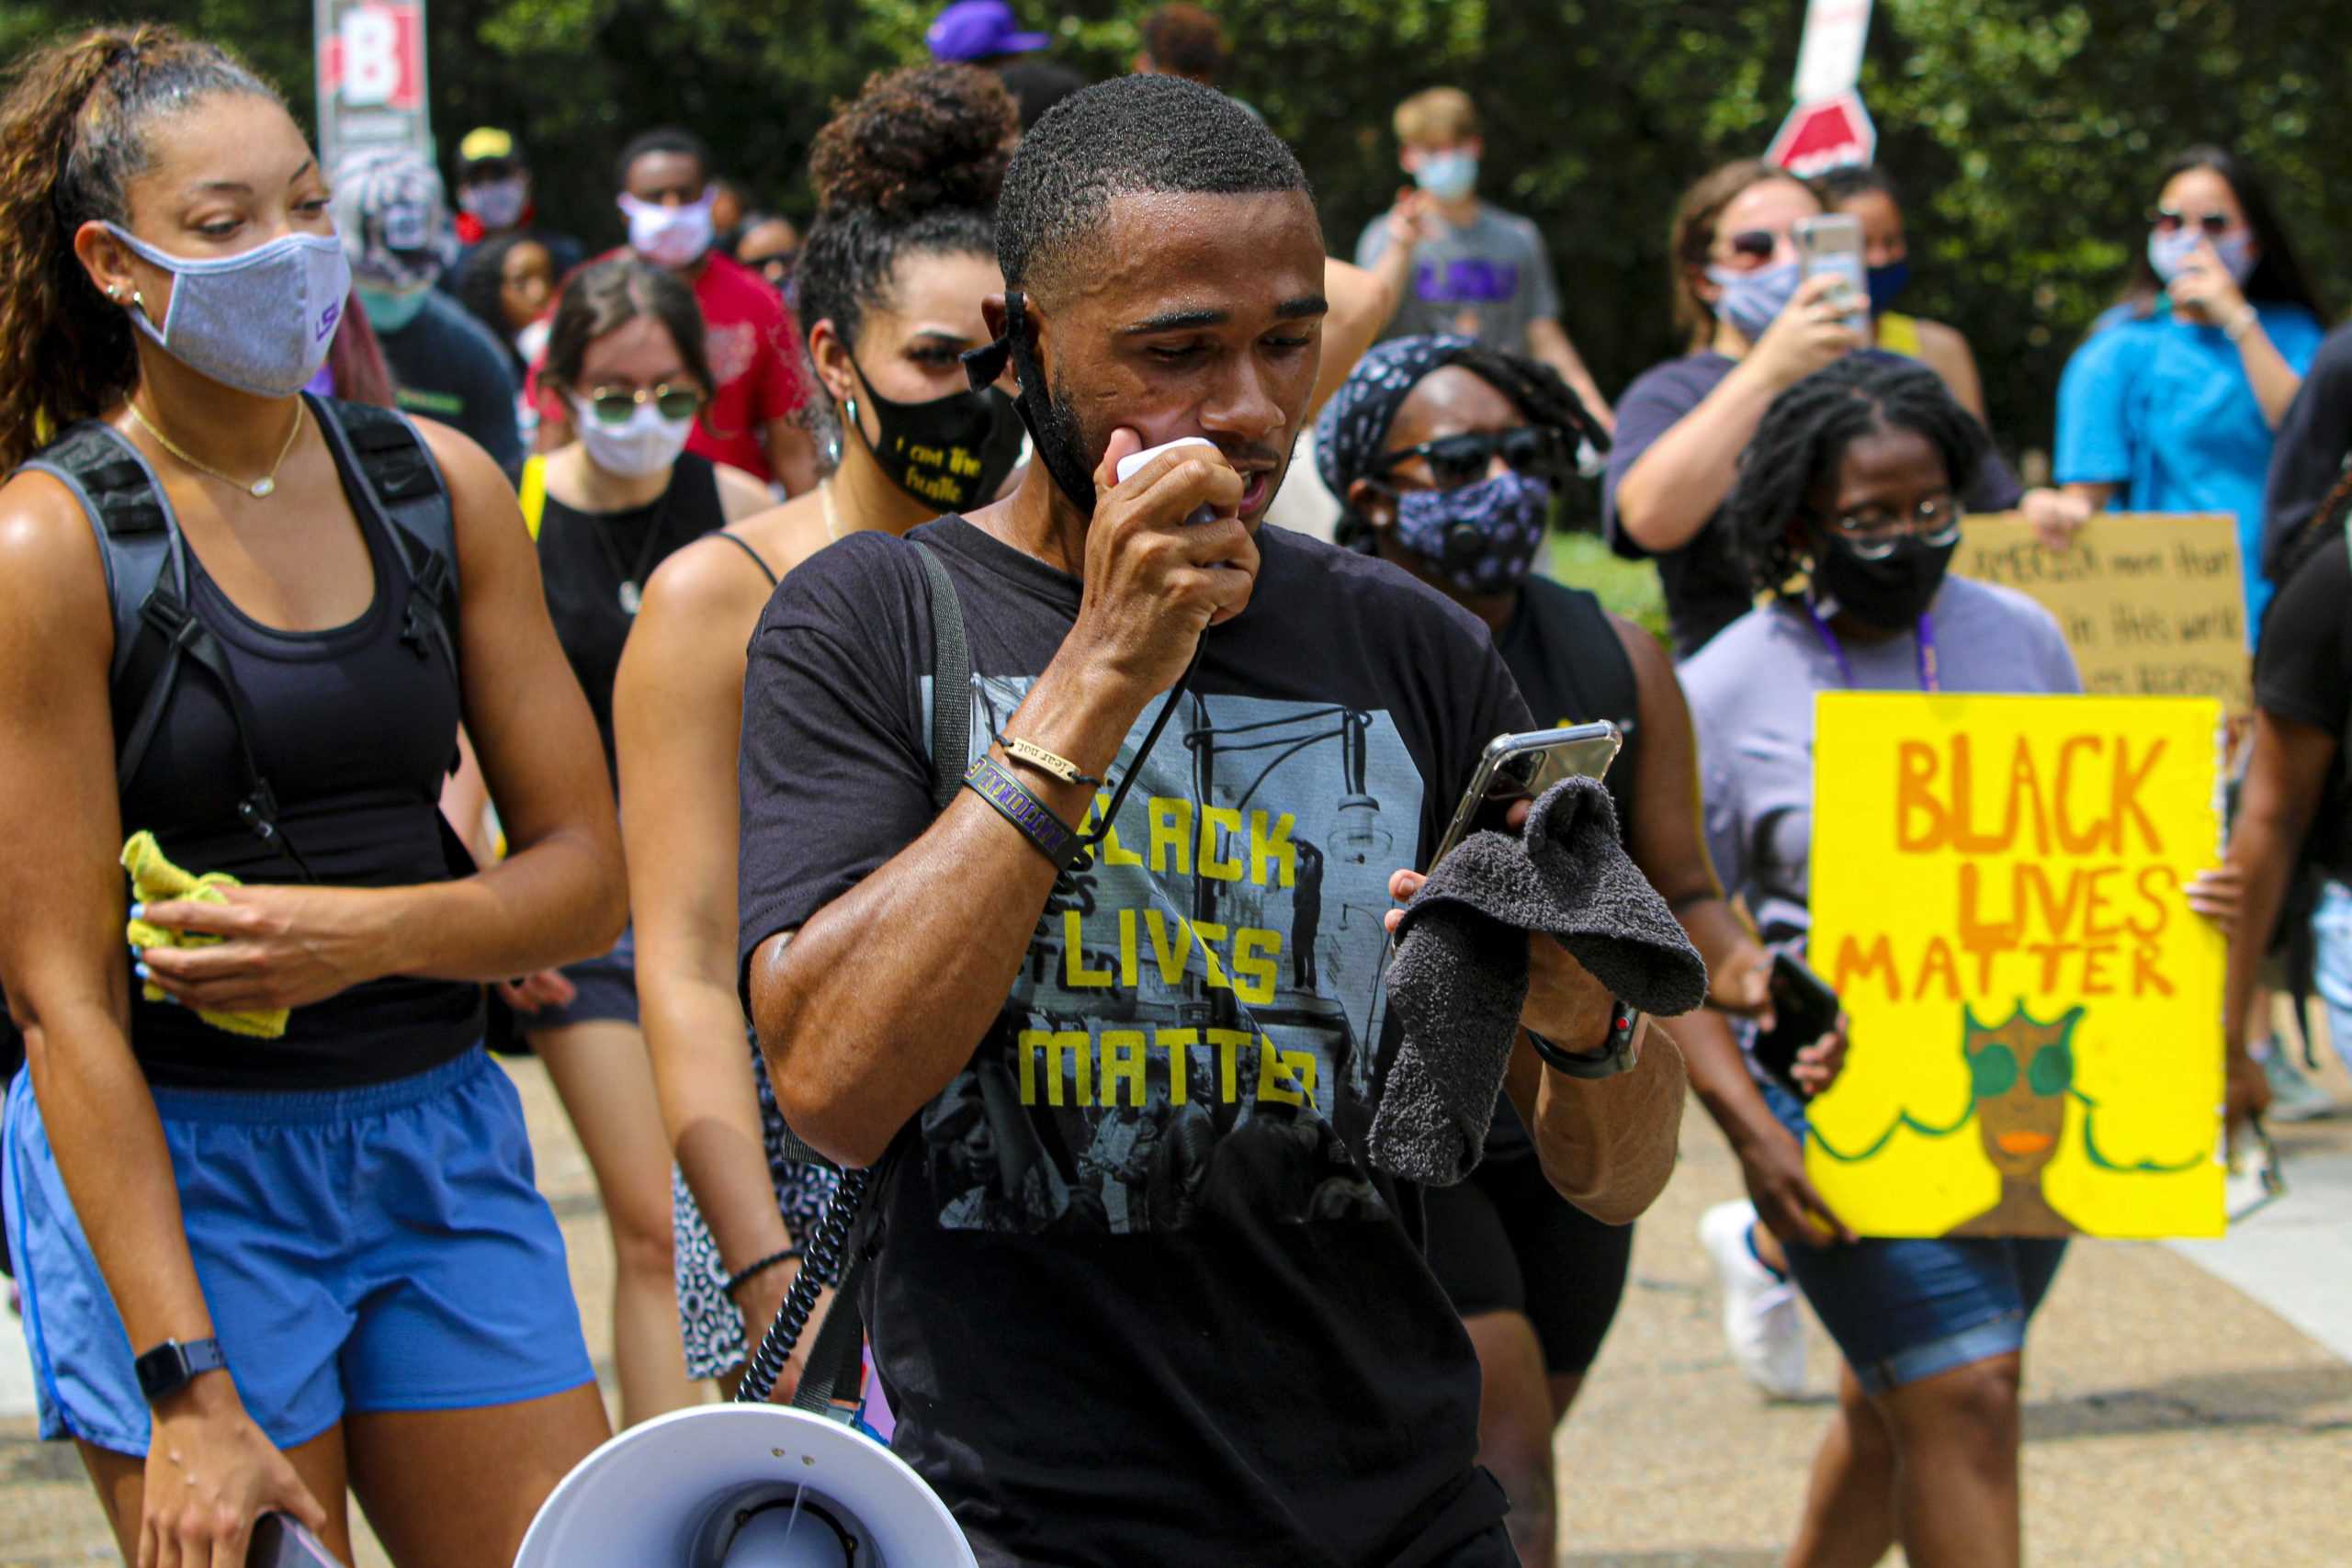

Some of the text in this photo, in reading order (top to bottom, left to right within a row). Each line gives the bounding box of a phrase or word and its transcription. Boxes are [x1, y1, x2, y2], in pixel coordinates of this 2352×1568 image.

[1076, 792, 1297, 888] LACK
[1896, 732, 2169, 857] BLACK
[1959, 862, 2179, 952] LIVES
[1064, 908, 1283, 1006] LIVES
[1835, 933, 2176, 1003] MATTER
